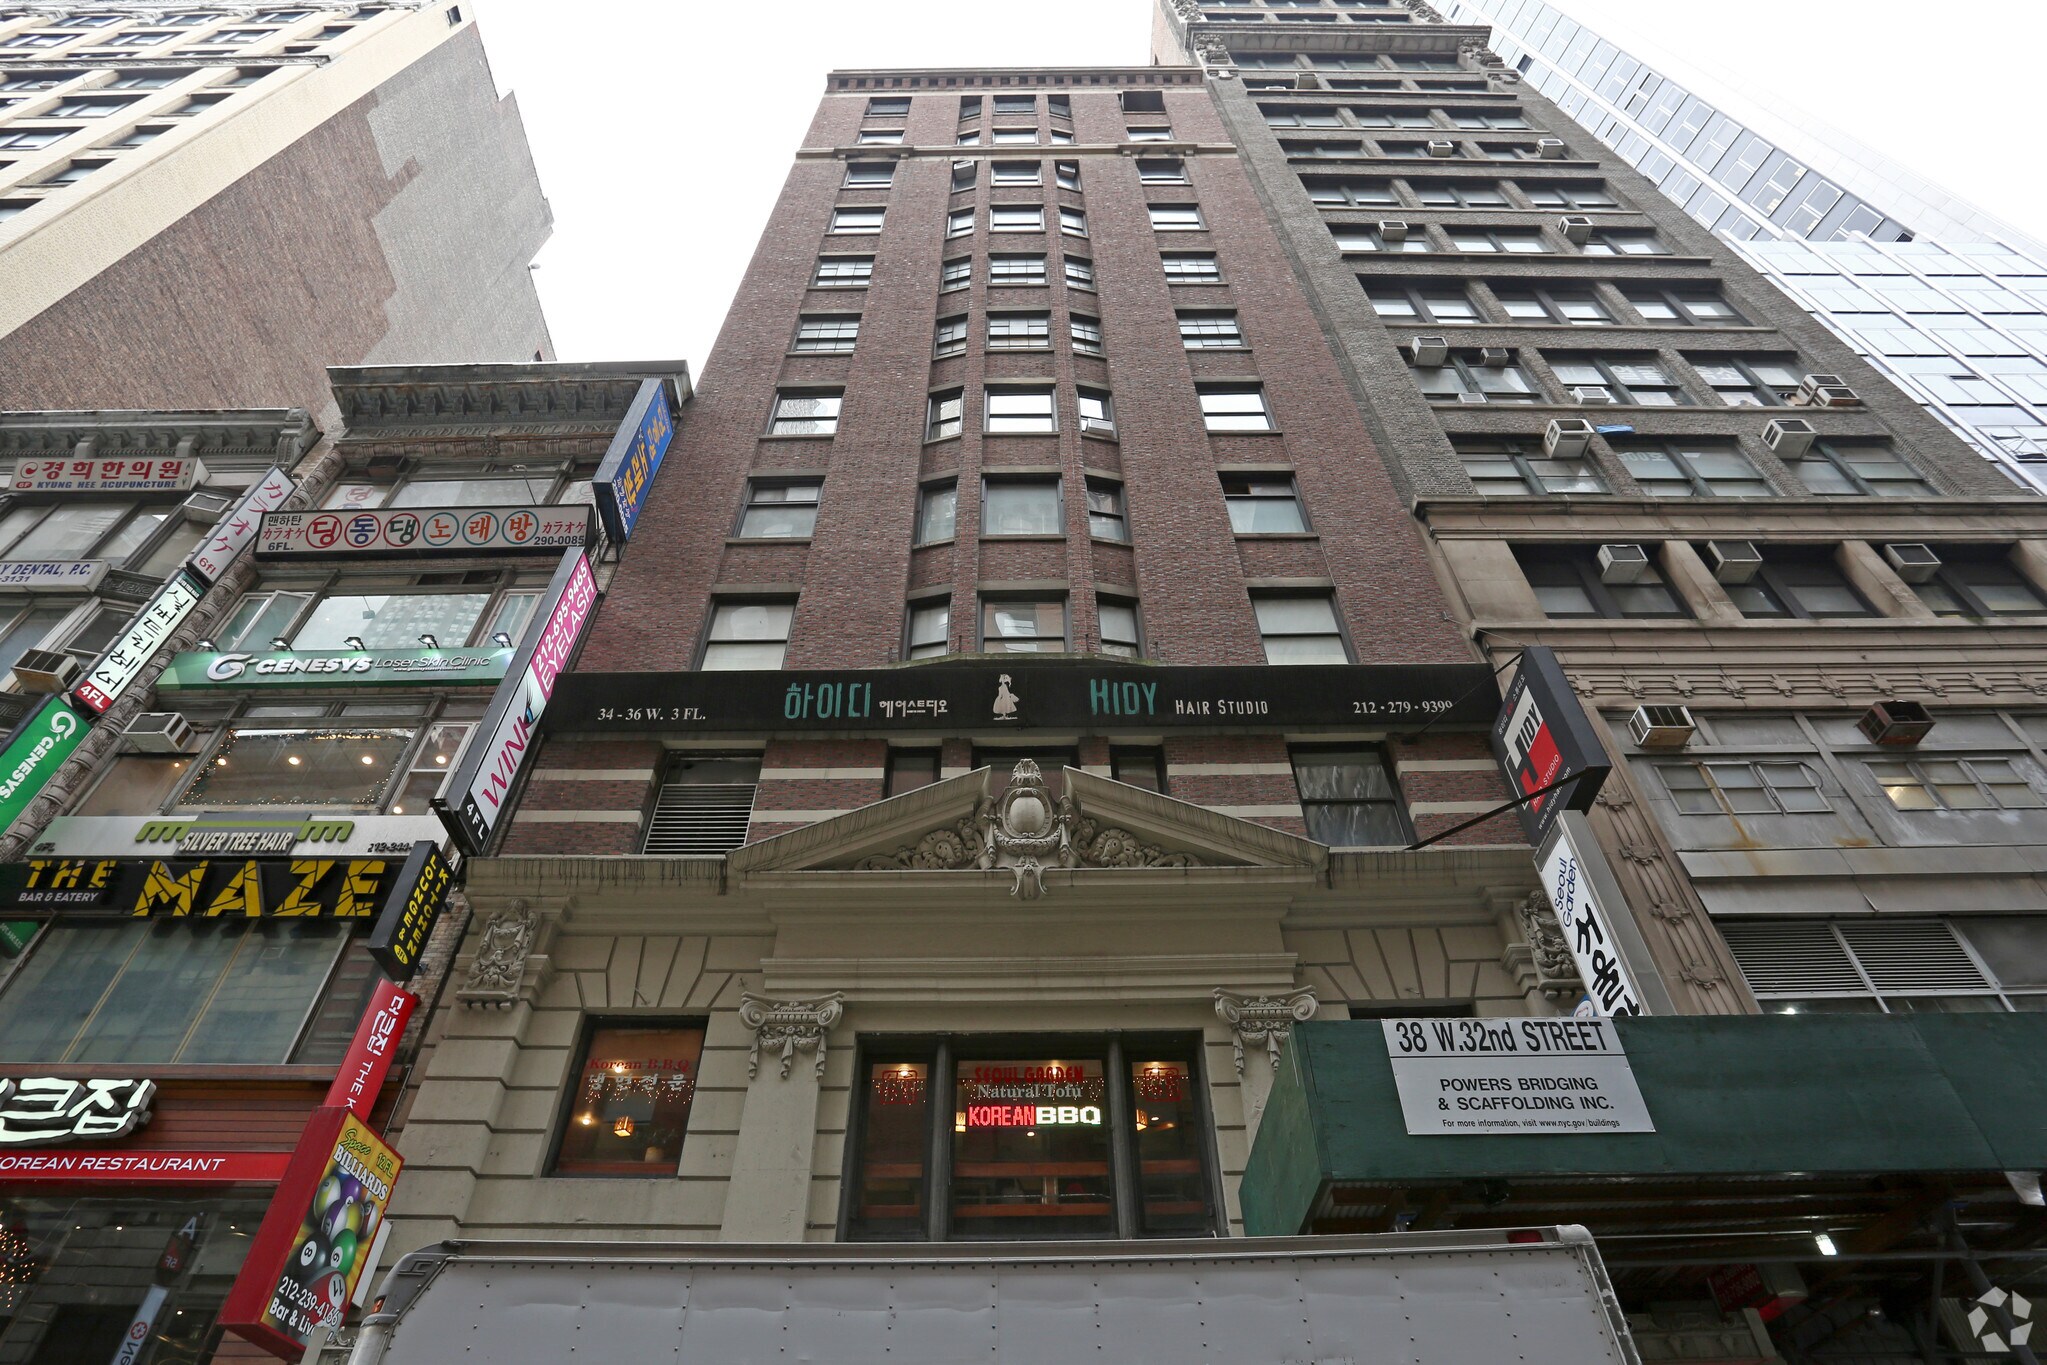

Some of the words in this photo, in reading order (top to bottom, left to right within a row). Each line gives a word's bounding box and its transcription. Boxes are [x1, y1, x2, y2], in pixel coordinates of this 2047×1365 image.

[375, 426, 496, 438] BERGDORF
[42, 461, 182, 479] 경희한의원
[37, 481, 72, 489] KYUNG
[77, 481, 96, 489] HEE
[268, 515, 302, 527] 맨하탄
[542, 521, 586, 534] カラオケ
[262, 527, 305, 541] カラオケ
[534, 535, 584, 545] 290-0085
[268, 542, 293, 550] 6FL.
[11, 564, 64, 577] DENTAL,
[69, 564, 91, 575] P.C.
[536, 560, 588, 672] 212-695-9465
[541, 577, 595, 693] EYELASH
[255, 657, 373, 673] GENESYS
[375, 657, 418, 667] Laser
[418, 656, 449, 667] Skin
[450, 655, 491, 666] Clinic
[80, 685, 104, 709] 4FL
[784, 682, 871, 719] 하이디
[1090, 679, 1157, 716] HIDY
[598, 708, 614, 720] 34
[625, 708, 642, 720] 36
[646, 708, 664, 720] W.
[671, 708, 679, 720] 3
[683, 708, 706, 720] FL.
[482, 714, 541, 808] WINK
[1543, 754, 1560, 786] STUDIO
[179, 832, 228, 850] SILVER
[228, 832, 257, 850] TREE
[257, 832, 293, 850] HAIR
[26, 860, 117, 888] THE
[133, 860, 387, 917] MAZE
[403, 854, 436, 928] LOUNGE
[1555, 857, 1568, 910] Seoul
[1563, 857, 1577, 928] Garden
[18, 892, 43, 902] BAR
[45, 892, 53, 902] &
[54, 892, 98, 902] EATERY
[407, 868, 449, 957] KITCHEN
[1396, 1021, 1427, 1052] 38
[1522, 1021, 1607, 1051] STREET
[589, 1058, 642, 1070] Korean
[350, 1061, 373, 1096] THE
[975, 1066, 1021, 1084] SEOUL
[1440, 1078, 1512, 1091] POWERS
[1518, 1077, 1599, 1090] BRIDGING
[977, 1084, 1042, 1098] Natural
[1043, 1084, 1083, 1098] Tofu
[1438, 1098, 1450, 1110] &
[1457, 1097, 1574, 1110] SCAFFOLDING
[1579, 1096, 1614, 1109] INC.
[969, 1106, 1036, 1127] KOREAN
[1036, 1106, 1101, 1125] BBQ
[1443, 1119, 1455, 1127] For
[1478, 1119, 1520, 1128] information,
[1522, 1119, 1537, 1127] visit
[0, 1157, 77, 1171] OREAN
[78, 1157, 225, 1171] RESTAURANT
[333, 1144, 388, 1200] BILLIARDS
[278, 1275, 340, 1326] 212-239-4166
[269, 1297, 289, 1321] Bar
[289, 1309, 298, 1327] &
